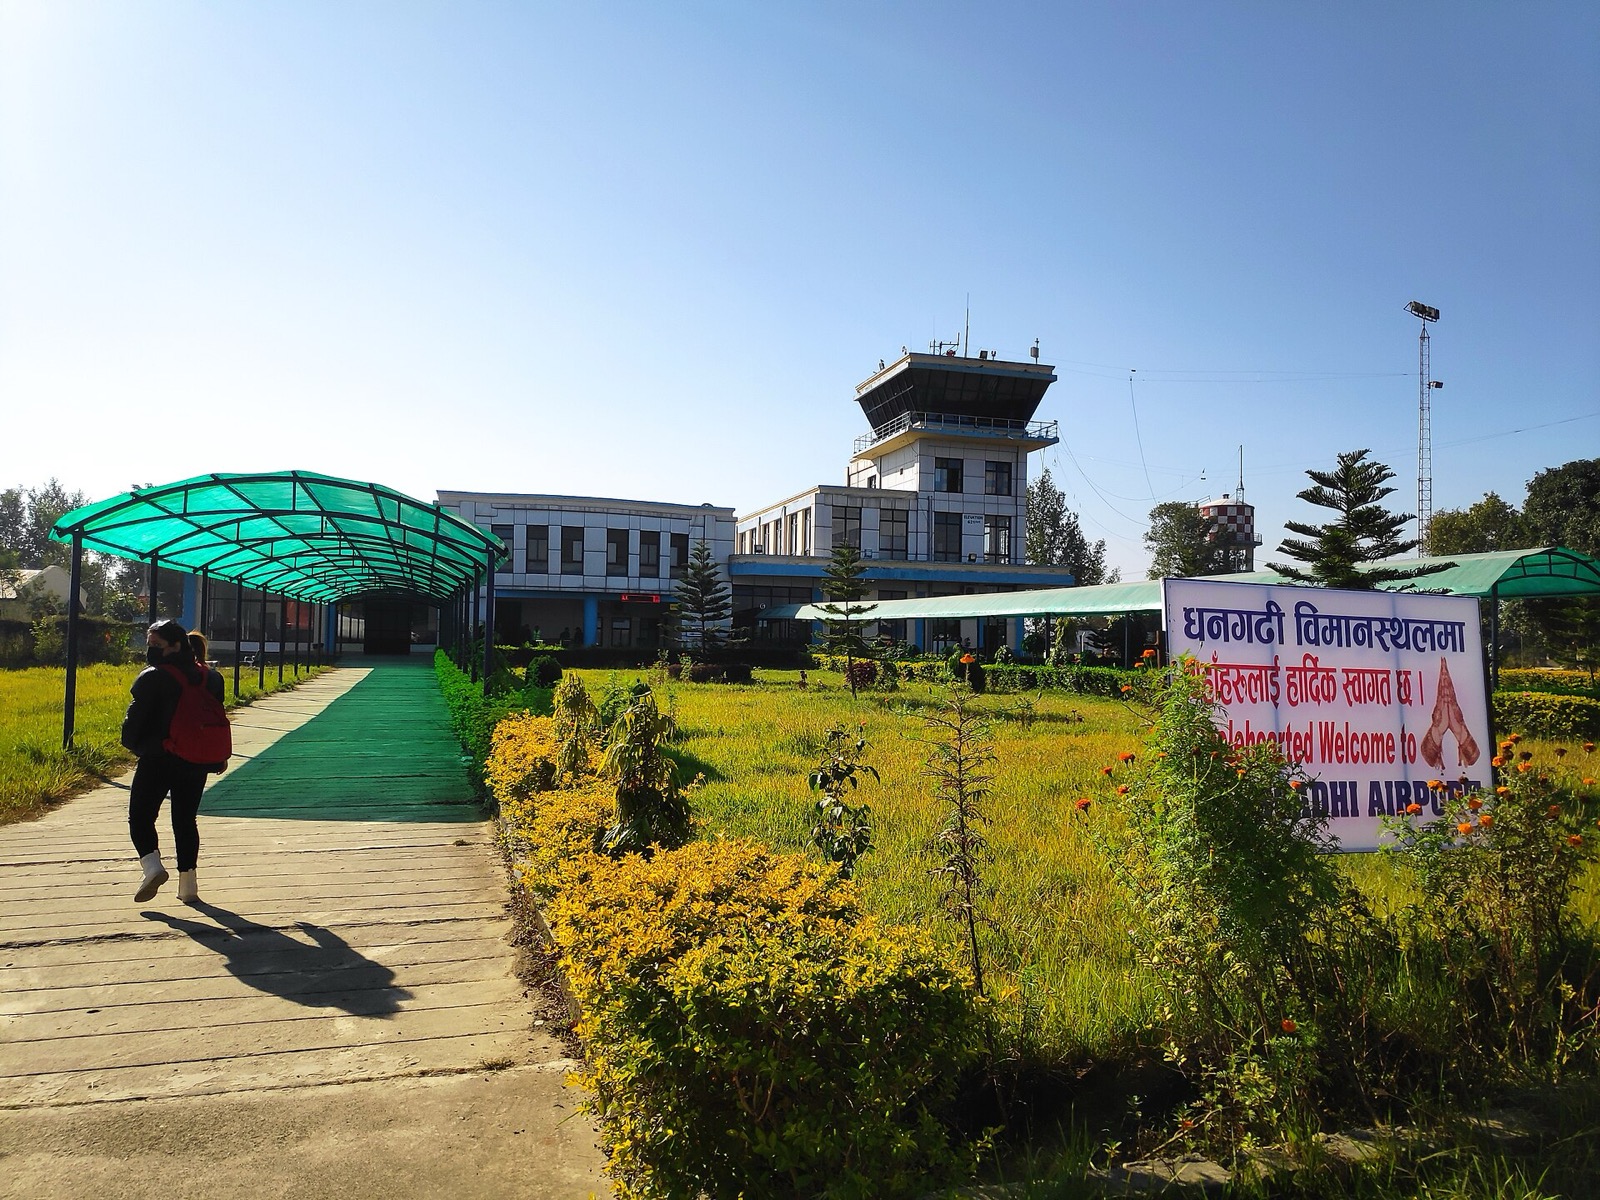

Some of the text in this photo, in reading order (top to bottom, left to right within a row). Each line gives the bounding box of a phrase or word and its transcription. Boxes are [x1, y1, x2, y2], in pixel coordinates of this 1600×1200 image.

[1183, 600, 1466, 652] धनगढी विमानस्थलमा
[1286, 653, 1337, 707] हार्दिक
[1342, 668, 1391, 707] स्वागत
[1319, 721, 1396, 764] Welcome
[1401, 724, 1417, 764] to
